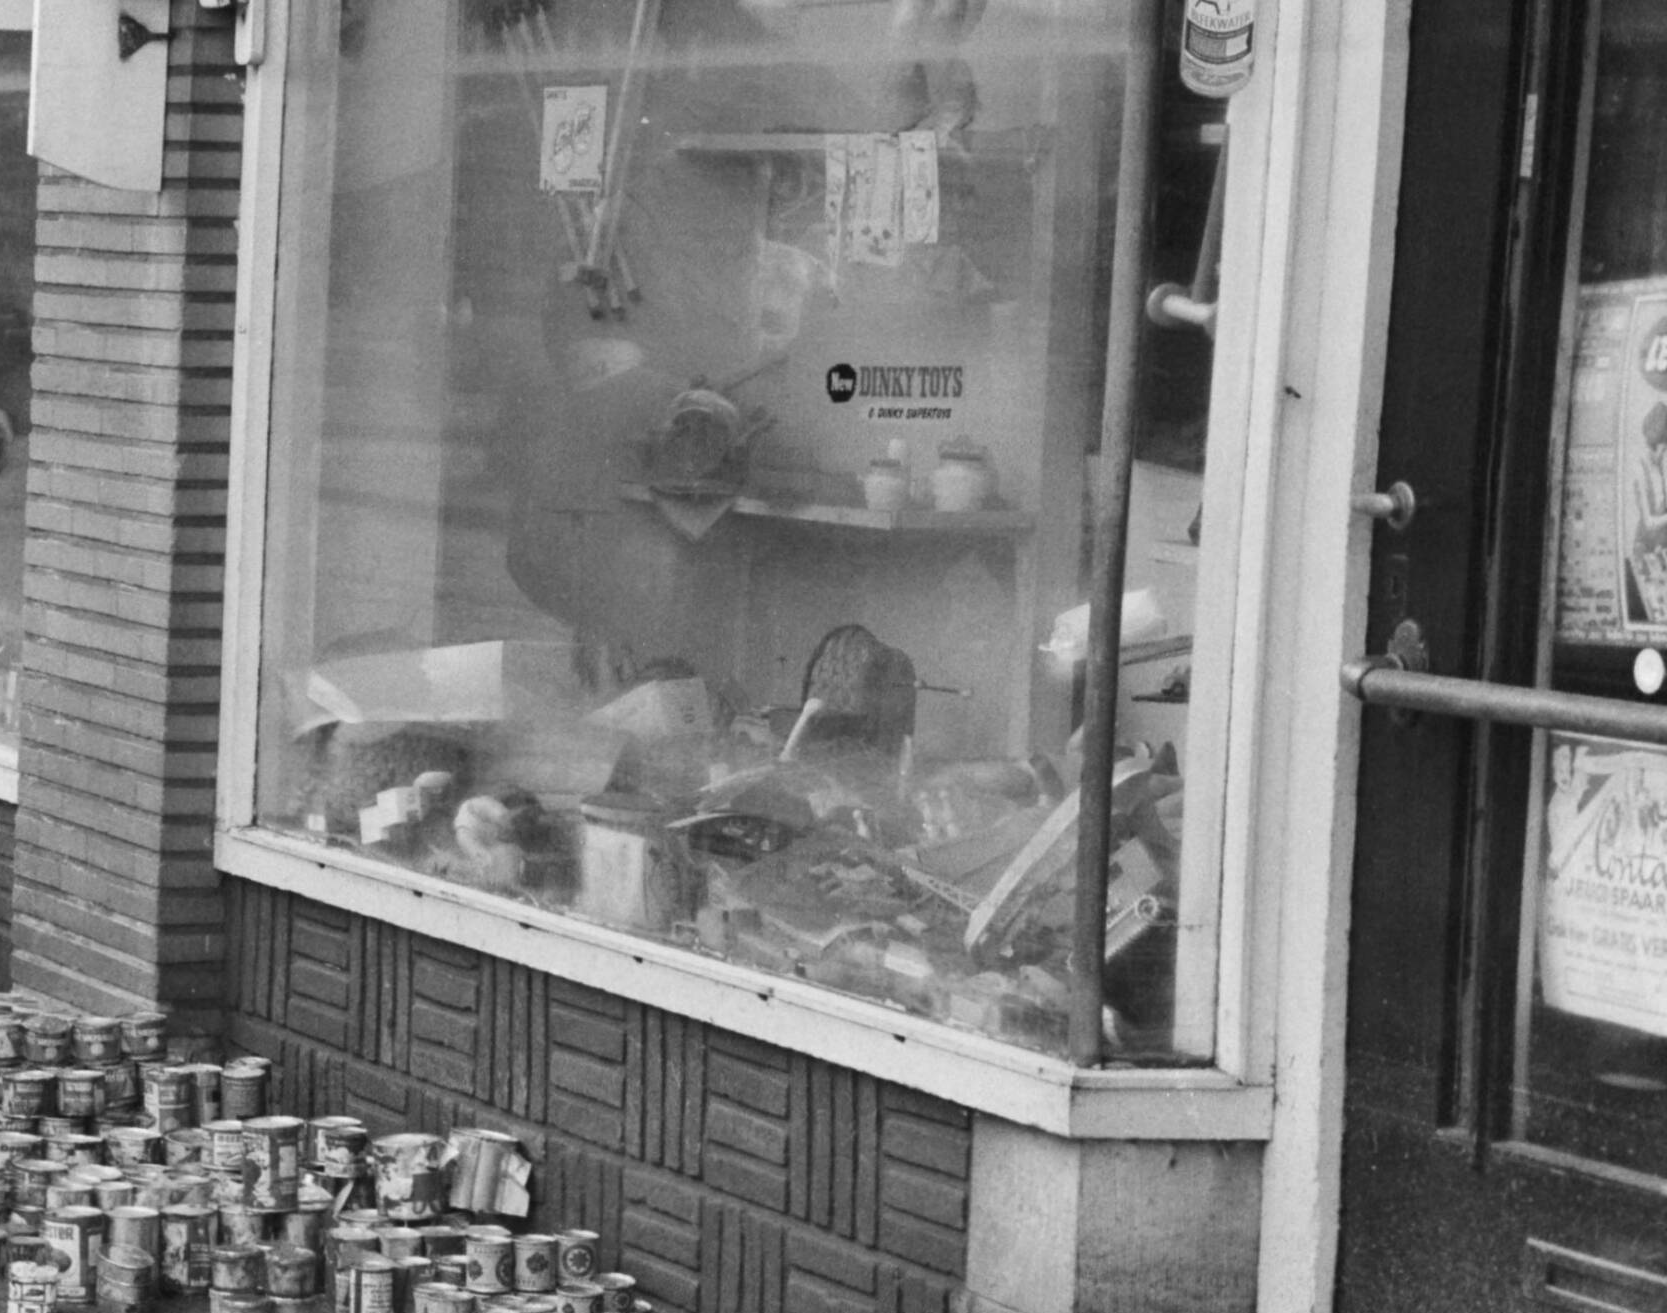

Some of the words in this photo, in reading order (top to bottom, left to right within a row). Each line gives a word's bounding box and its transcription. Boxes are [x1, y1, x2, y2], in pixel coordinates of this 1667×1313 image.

[830, 371, 854, 392] New
[859, 366, 916, 398] DINKY
[918, 366, 963, 398] TOYS
